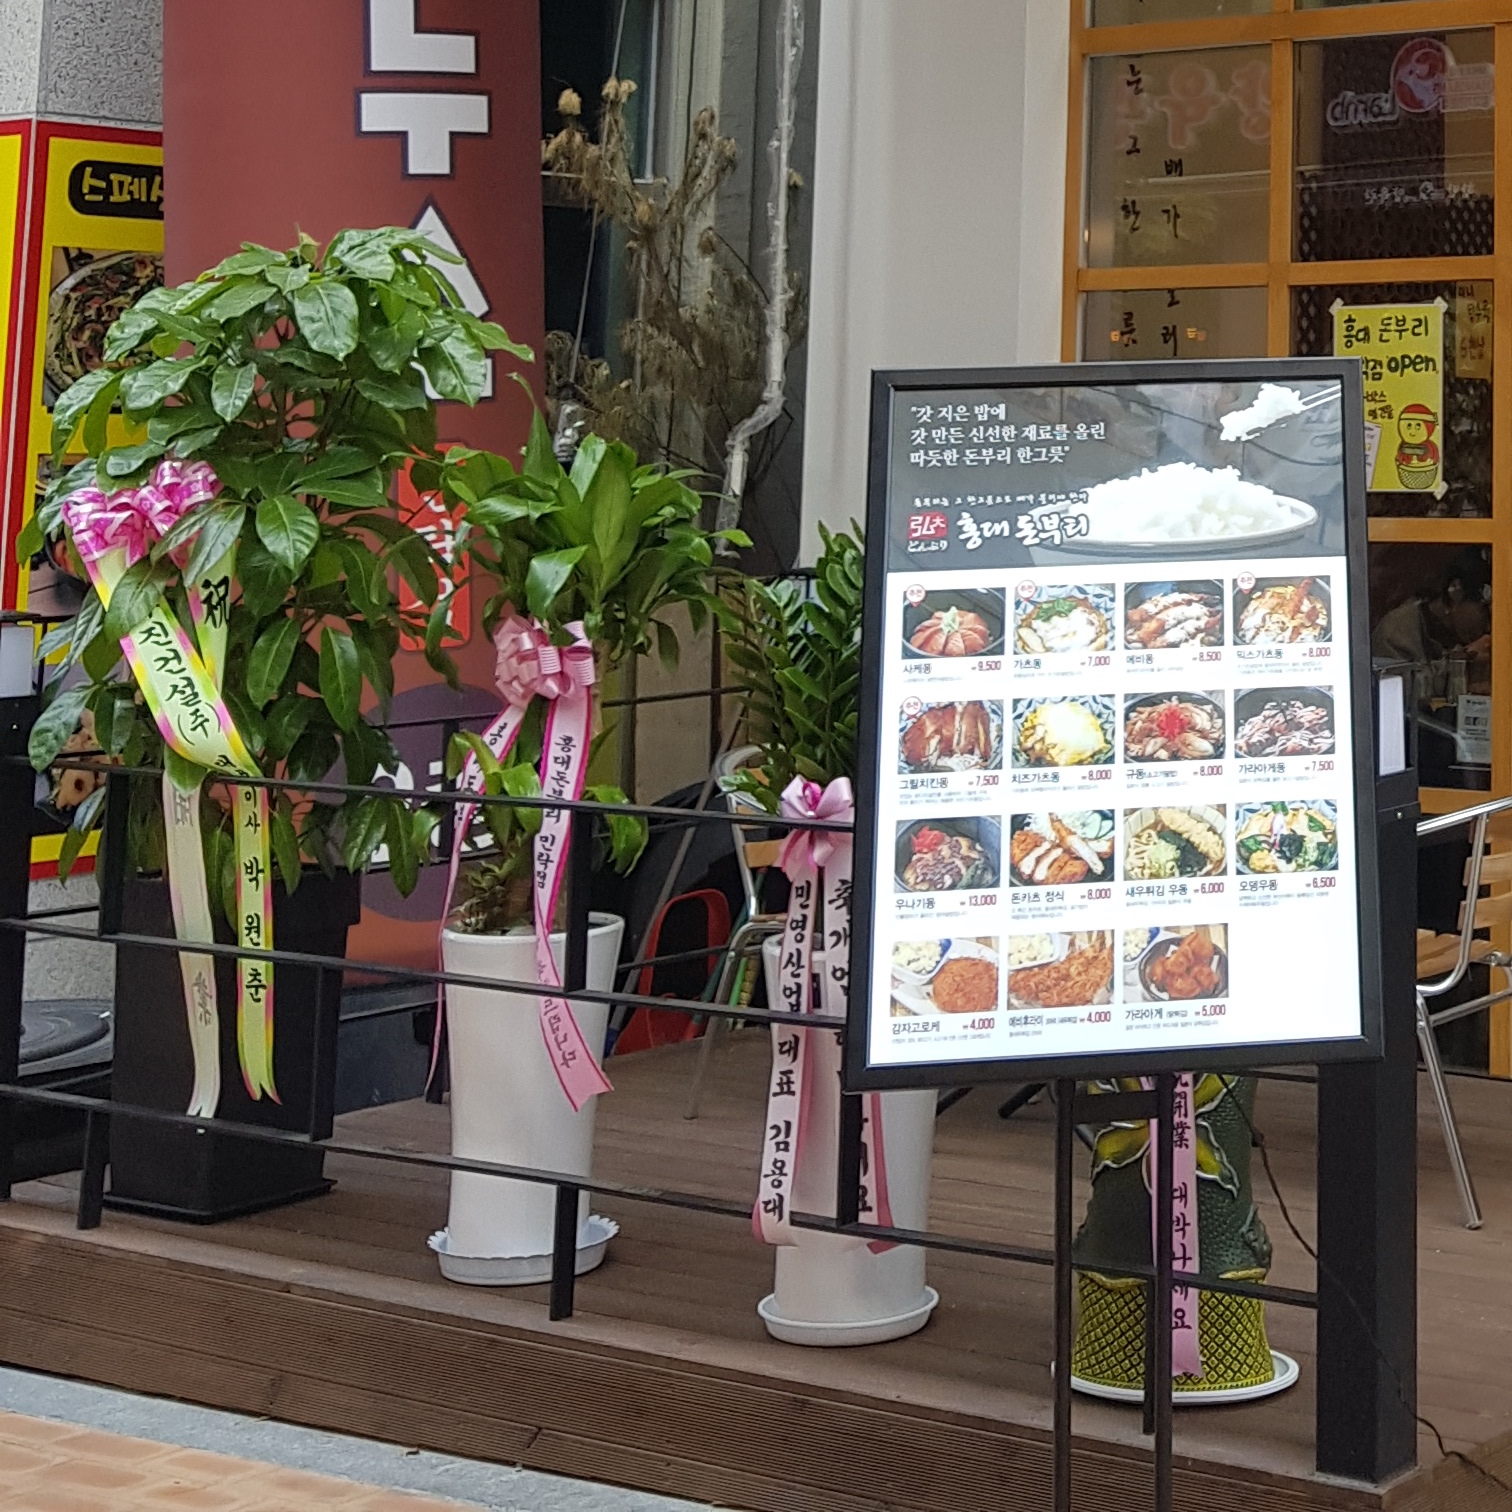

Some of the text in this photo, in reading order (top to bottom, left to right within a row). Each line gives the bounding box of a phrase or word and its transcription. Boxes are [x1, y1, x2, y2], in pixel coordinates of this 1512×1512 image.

[1343, 314, 1371, 349] 홍대
[1379, 315, 1429, 343] 돈부리
[937, 405, 971, 422] 지은
[974, 403, 1006, 422] 밥에
[910, 422, 1106, 445] 갓 만든 신선한 재료를 올린
[909, 450, 959, 468] 따듯한
[962, 448, 1011, 465] 돈부리
[956, 511, 1089, 551] 홍대 돈부리
[200, 574, 230, 629] 祝
[1044, 890, 1065, 903] 정식
[1167, 883, 1188, 896] 우동
[1125, 1007, 1163, 1021] 가라아게
[891, 1020, 940, 1035] 감자고로케
